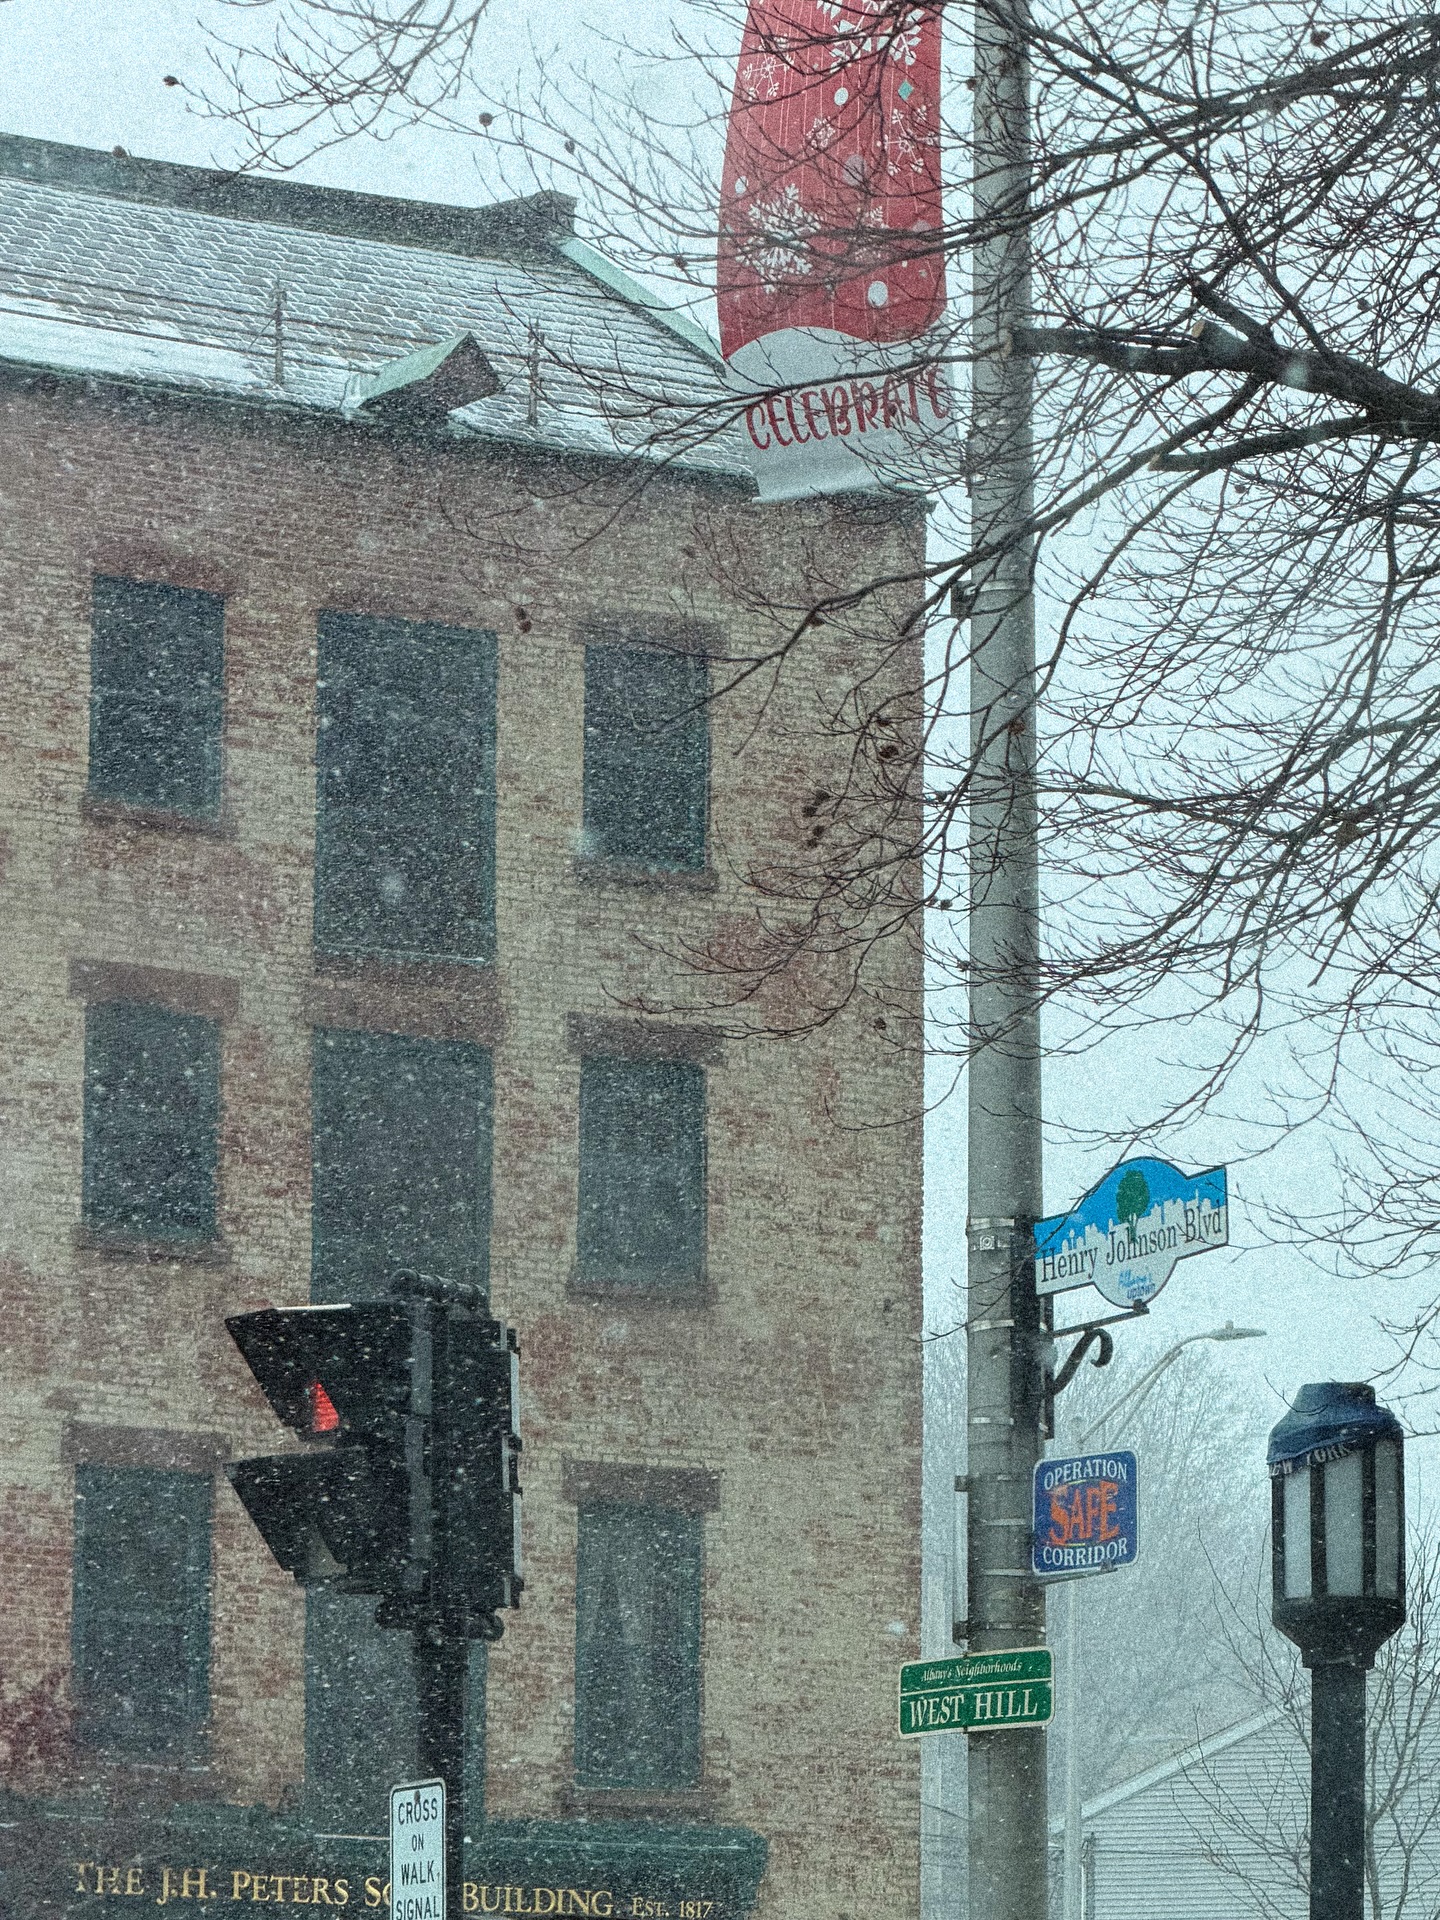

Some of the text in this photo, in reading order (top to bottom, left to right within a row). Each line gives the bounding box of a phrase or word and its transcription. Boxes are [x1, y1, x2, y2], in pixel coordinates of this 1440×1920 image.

[745, 367, 951, 450] CELEBRATE
[1041, 1203, 1221, 1282] Henry Johnson Blvd
[1043, 1458, 1128, 1491] OPERATION
[1046, 1479, 1120, 1546] SAFE
[1042, 1537, 1128, 1567] CORRIDOR
[956, 1658, 1022, 1679] Neighborhoods
[909, 1688, 1038, 1728] WEST HILL
[398, 1798, 438, 1826] CROSS
[411, 1834, 424, 1852] ON
[400, 1860, 435, 1887] WALK
[73, 1860, 145, 1895] THE
[156, 1866, 217, 1905] J.H.
[231, 1870, 349, 1905] PETERS
[463, 1882, 614, 1916] BUILDING
[632, 1897, 670, 1917] EST.
[679, 1900, 714, 1919] 1817
[396, 1896, 440, 1920] SIGNAL
